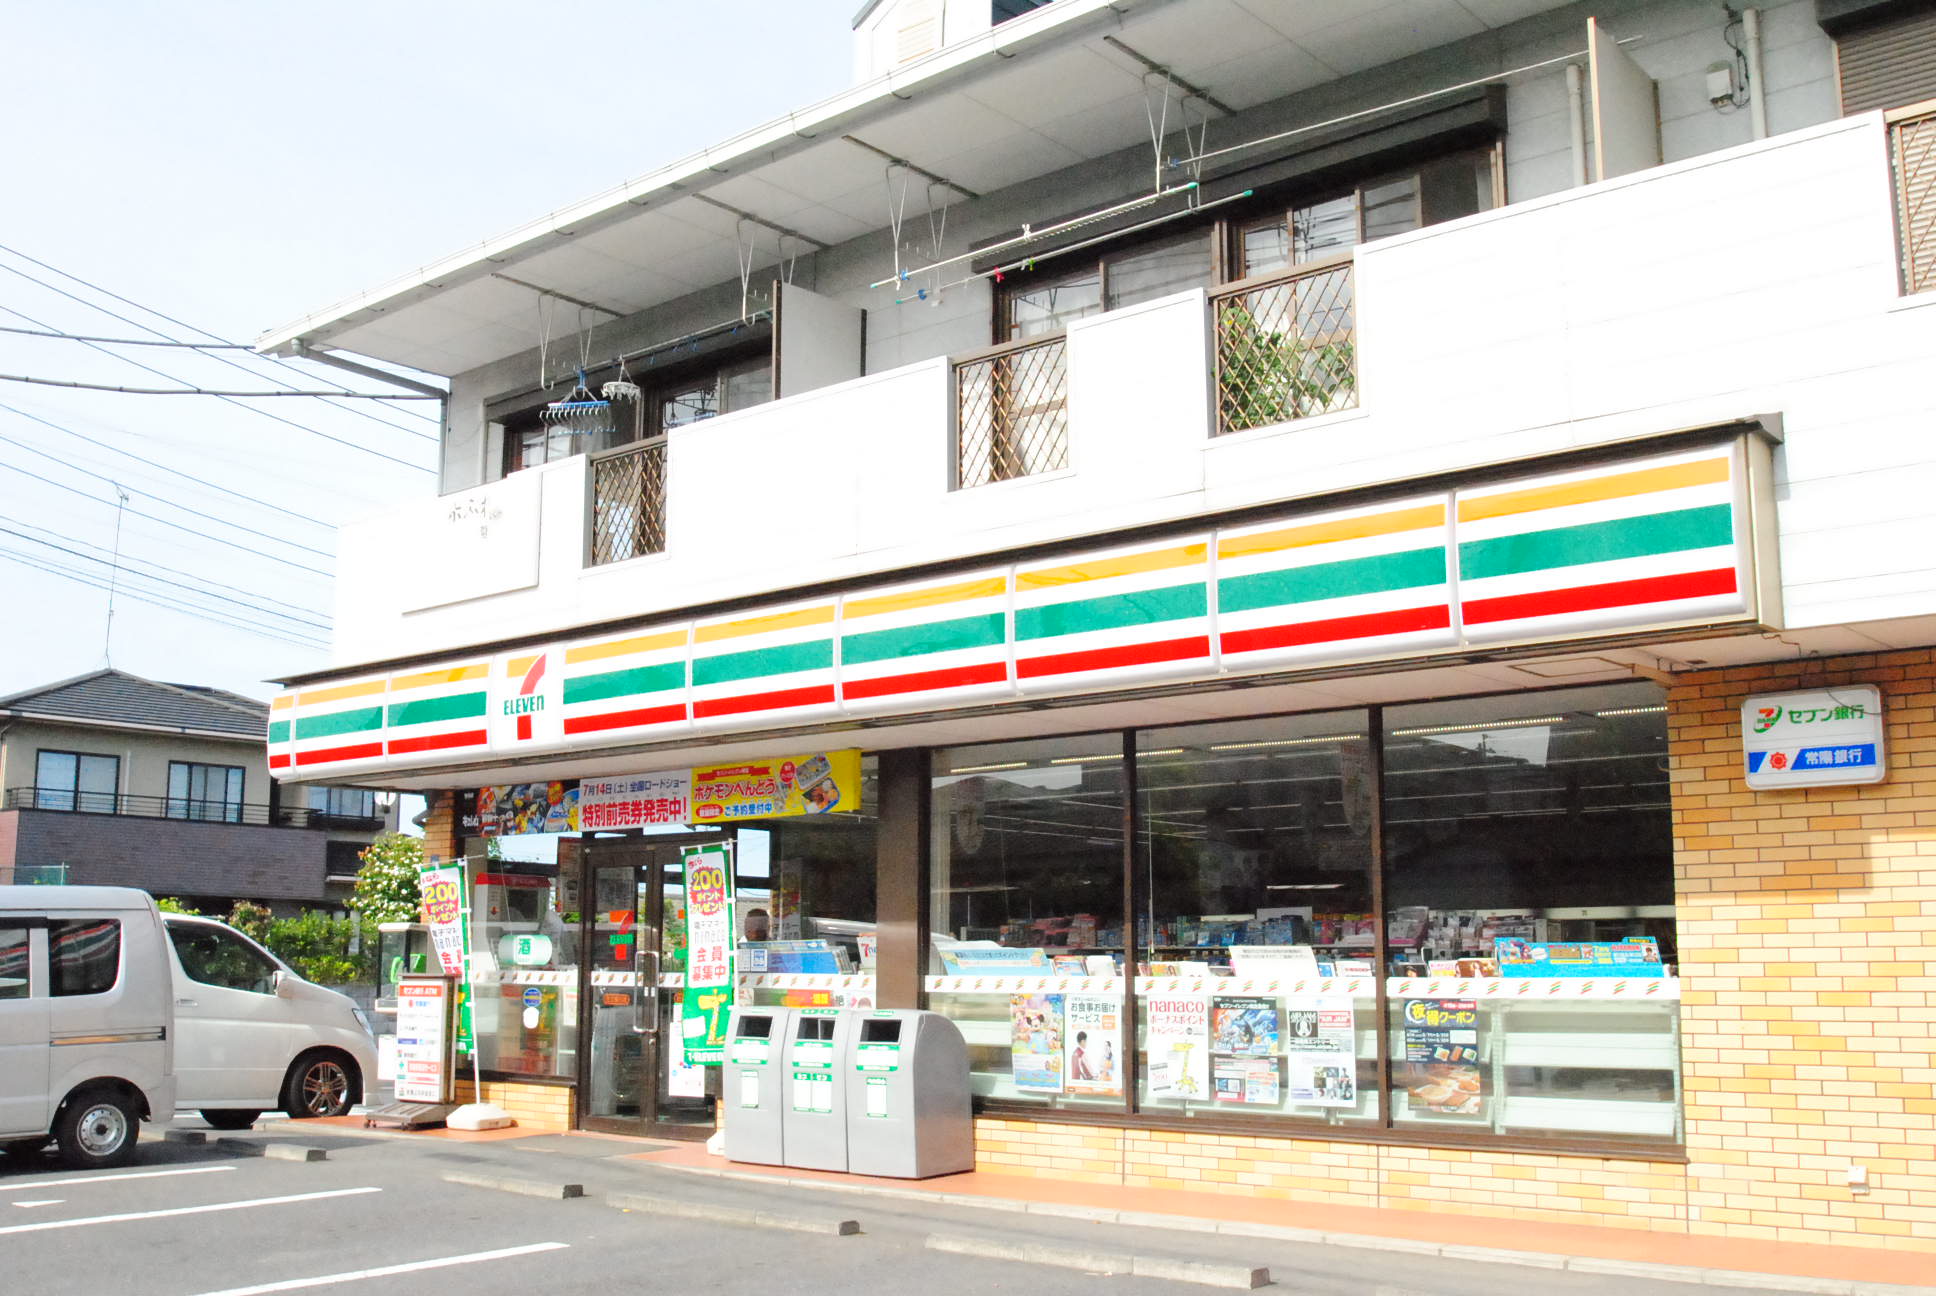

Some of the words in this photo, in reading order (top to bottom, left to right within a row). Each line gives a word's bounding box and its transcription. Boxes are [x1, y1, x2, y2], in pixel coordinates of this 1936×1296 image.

[1788, 704, 1865, 724] セブン銀行
[1804, 748, 1862, 766] 常陽銀行
[691, 869, 723, 892] 200
[424, 882, 459, 905] 200
[517, 937, 532, 955] 酒
[697, 946, 723, 962] 会員
[692, 964, 726, 981] 募集中
[1070, 1002, 1116, 1013] お食事お届け
[1149, 1000, 1205, 1013] nanaco
[1070, 1014, 1101, 1024] サービス
[1150, 1015, 1205, 1025] ボーナスポイント
